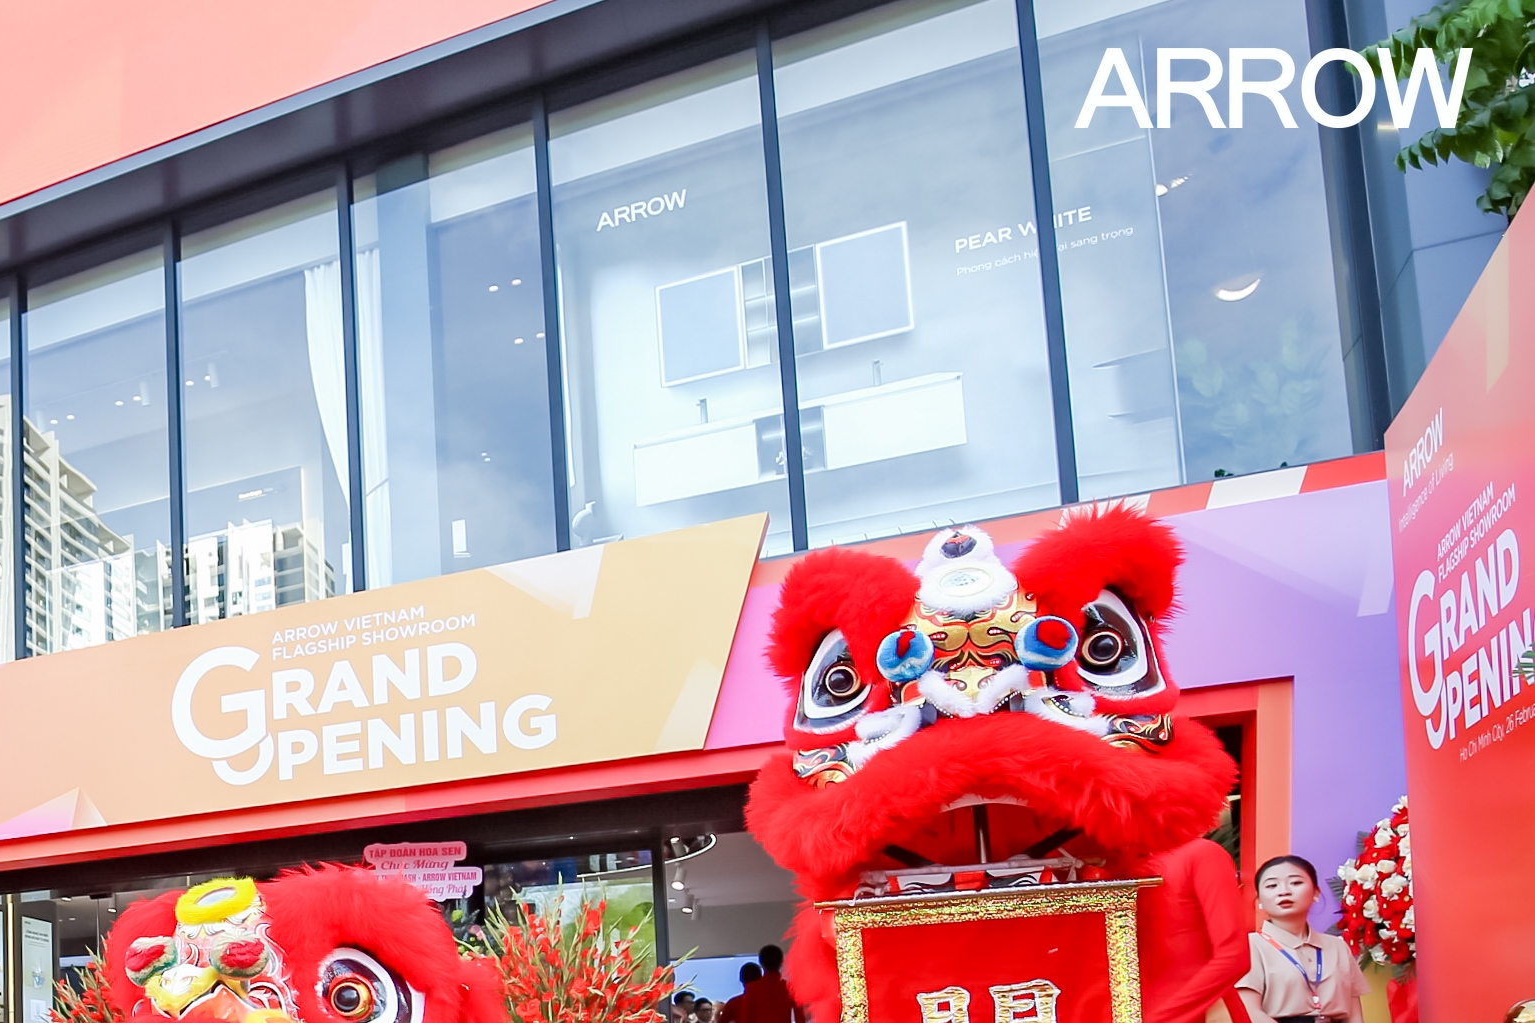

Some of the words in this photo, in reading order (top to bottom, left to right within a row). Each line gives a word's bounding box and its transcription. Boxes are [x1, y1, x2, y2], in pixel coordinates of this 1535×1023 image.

[594, 188, 688, 233] ARROW
[954, 226, 1013, 254] PEAR
[1017, 206, 1092, 237] WITE
[956, 261, 993, 277] Phong
[994, 253, 1021, 268] cách
[1070, 233, 1098, 249] sang
[1100, 226, 1134, 242] trọng
[1401, 407, 1445, 497] ARROW
[1397, 484, 1430, 534] Intelligence
[1427, 471, 1436, 494] of
[1434, 452, 1454, 486] Living
[1437, 518, 1461, 562] ARROW
[1461, 480, 1495, 531] VIETNAM
[1437, 535, 1469, 584] FLAGSHIP
[1469, 482, 1516, 549] SHOWROOM
[271, 620, 339, 645] ARROW
[343, 604, 426, 634] VIETNAM
[271, 634, 357, 661] FLAGSHIP
[361, 613, 477, 646] SHOWROOM
[1407, 528, 1520, 717] GRAND
[171, 643, 478, 760] GRAND
[1424, 606, 1535, 751] OPENIN
[211, 693, 558, 786] OPENING
[1459, 746, 1468, 763] Ho
[1477, 729, 1492, 752] Minh
[1505, 713, 1514, 734] 26
[368, 846, 387, 861] TẬP
[389, 845, 416, 858] ĐOÀN
[419, 847, 439, 857] HOA
[441, 846, 462, 856] SEN
[413, 860, 450, 871] Mừng
[422, 873, 446, 882] ARROW
[447, 871, 477, 881] VIETNAM
